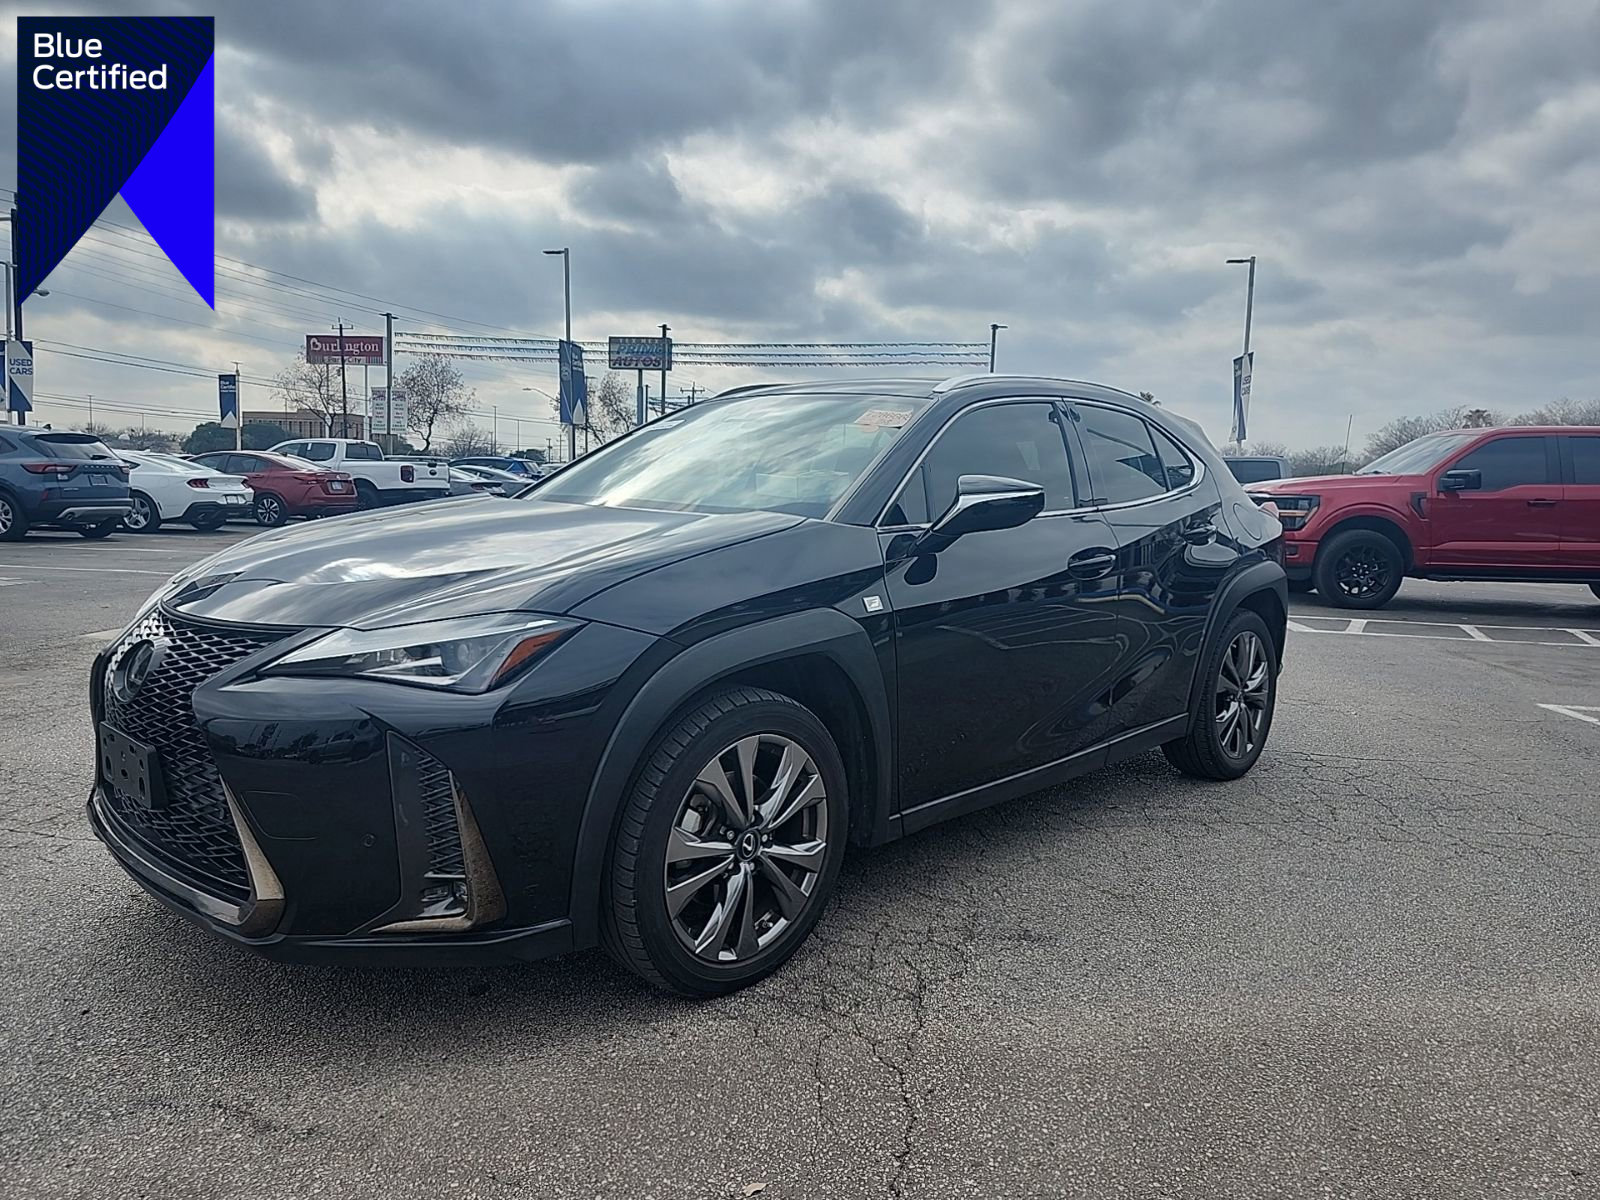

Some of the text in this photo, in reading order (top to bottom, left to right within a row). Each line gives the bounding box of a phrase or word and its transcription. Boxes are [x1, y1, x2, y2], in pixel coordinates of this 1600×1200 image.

[310, 337, 379, 355] Burlngton
[10, 358, 32, 366] USED
[612, 356, 662, 367] AUTOS
[10, 367, 33, 375] CARS
